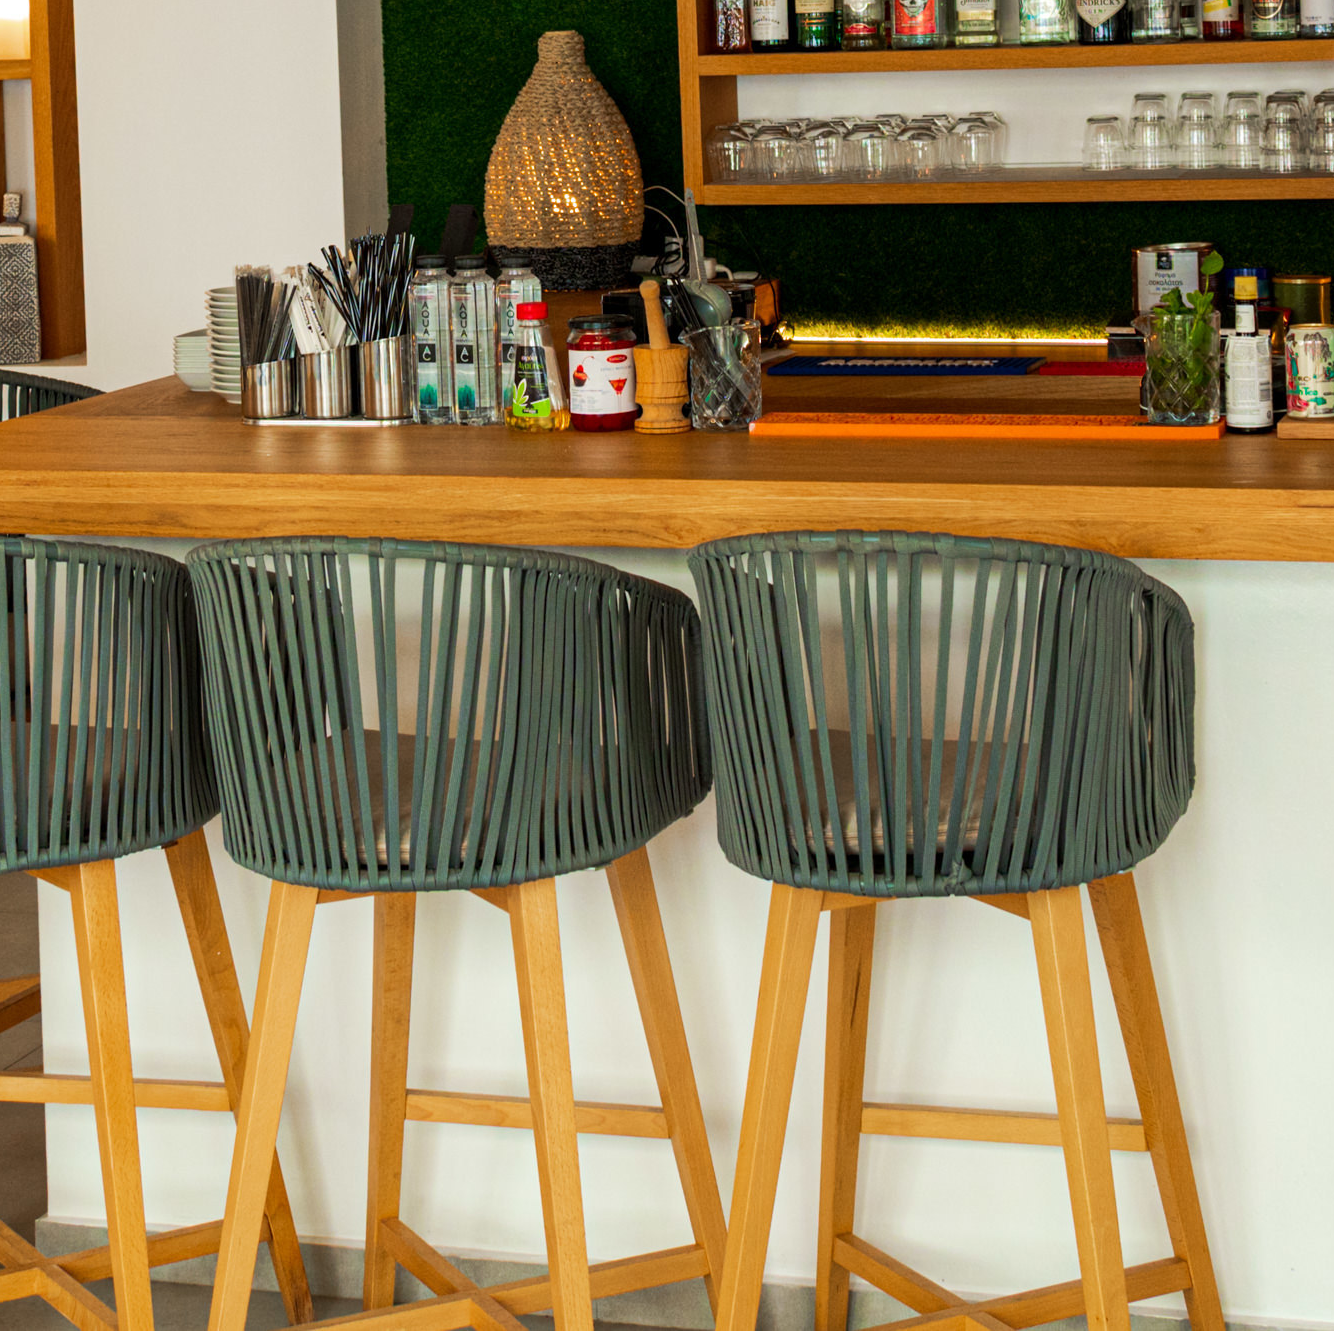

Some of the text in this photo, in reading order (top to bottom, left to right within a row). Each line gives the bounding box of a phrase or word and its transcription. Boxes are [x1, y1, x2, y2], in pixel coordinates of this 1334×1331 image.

[753, 0, 776, 7] HAIG
[421, 302, 430, 337] AQUA
[459, 303, 468, 338] AQUA
[506, 302, 515, 337] AQUA
